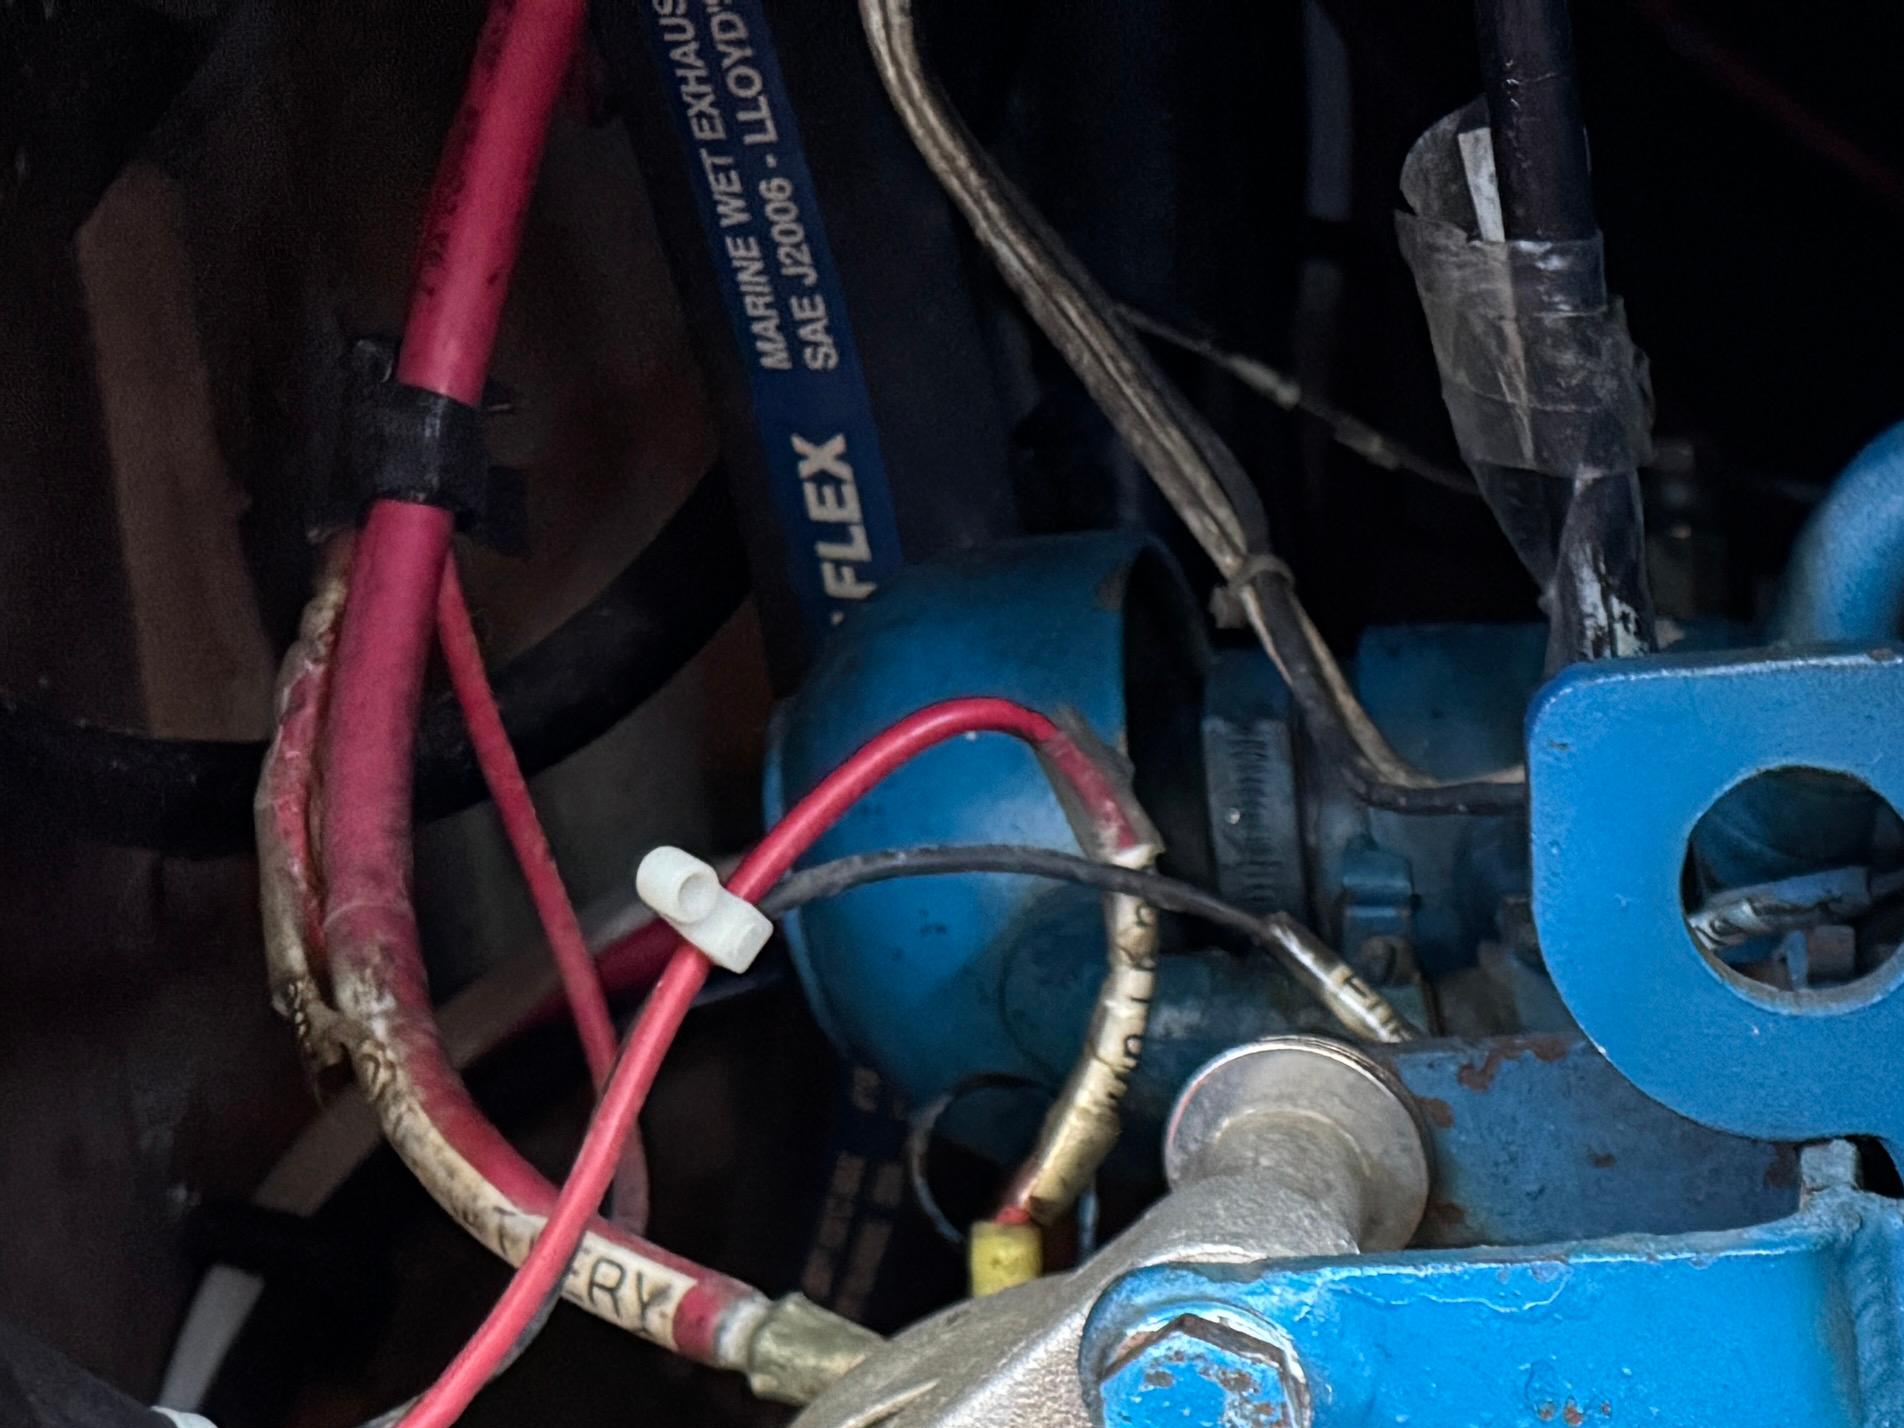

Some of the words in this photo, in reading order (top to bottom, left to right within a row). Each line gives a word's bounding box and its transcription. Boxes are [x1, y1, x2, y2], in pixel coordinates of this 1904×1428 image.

[700, 148, 753, 228] WET
[759, 176, 819, 286] J2006
[726, 236, 792, 370] MARINE
[792, 294, 838, 371] SAE
[789, 431, 878, 600] FLEX
